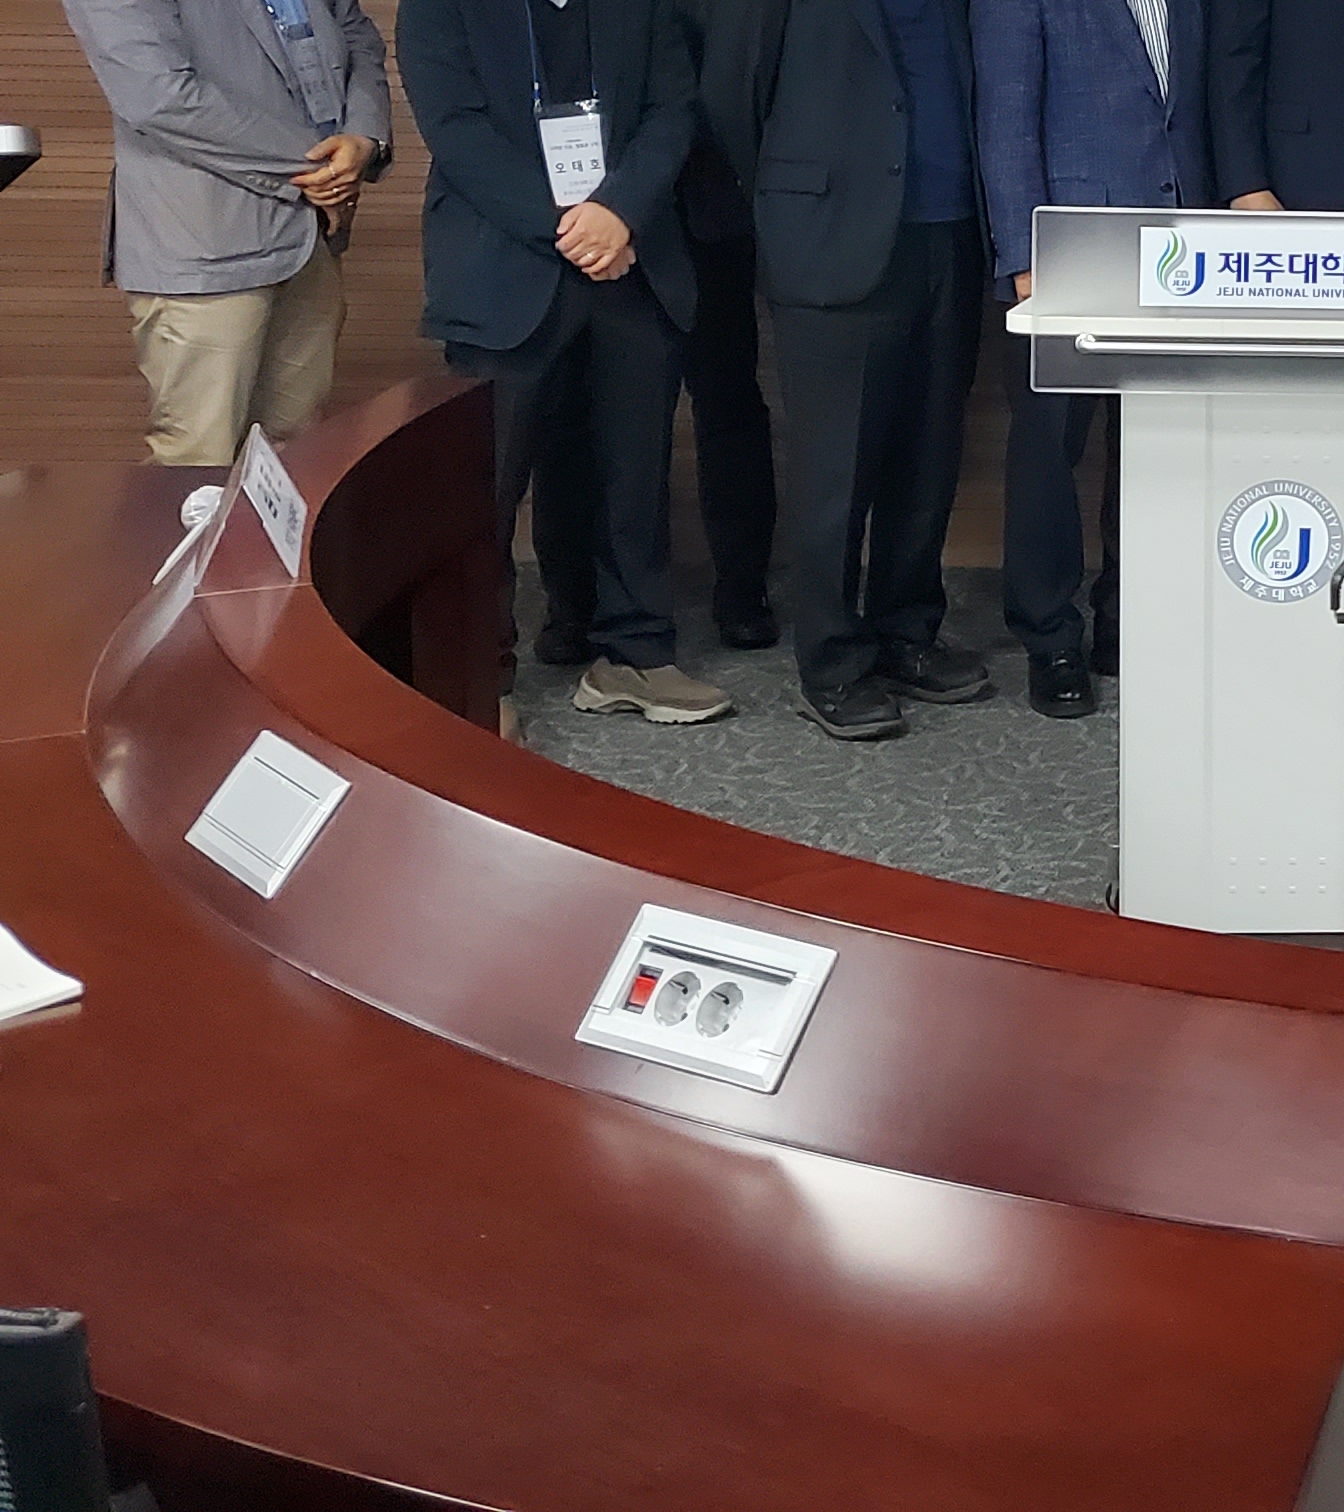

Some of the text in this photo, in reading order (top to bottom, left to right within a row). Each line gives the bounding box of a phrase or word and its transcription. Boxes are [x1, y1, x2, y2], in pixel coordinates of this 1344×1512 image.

[1216, 287, 1244, 297] JEJU
[1248, 288, 1309, 298] NATIONAL
[1220, 482, 1342, 569] JEJU NATIONAL UNIVERSITY 1952
[1269, 561, 1292, 569] JEJU
[1239, 575, 1320, 601] 제주대학교
